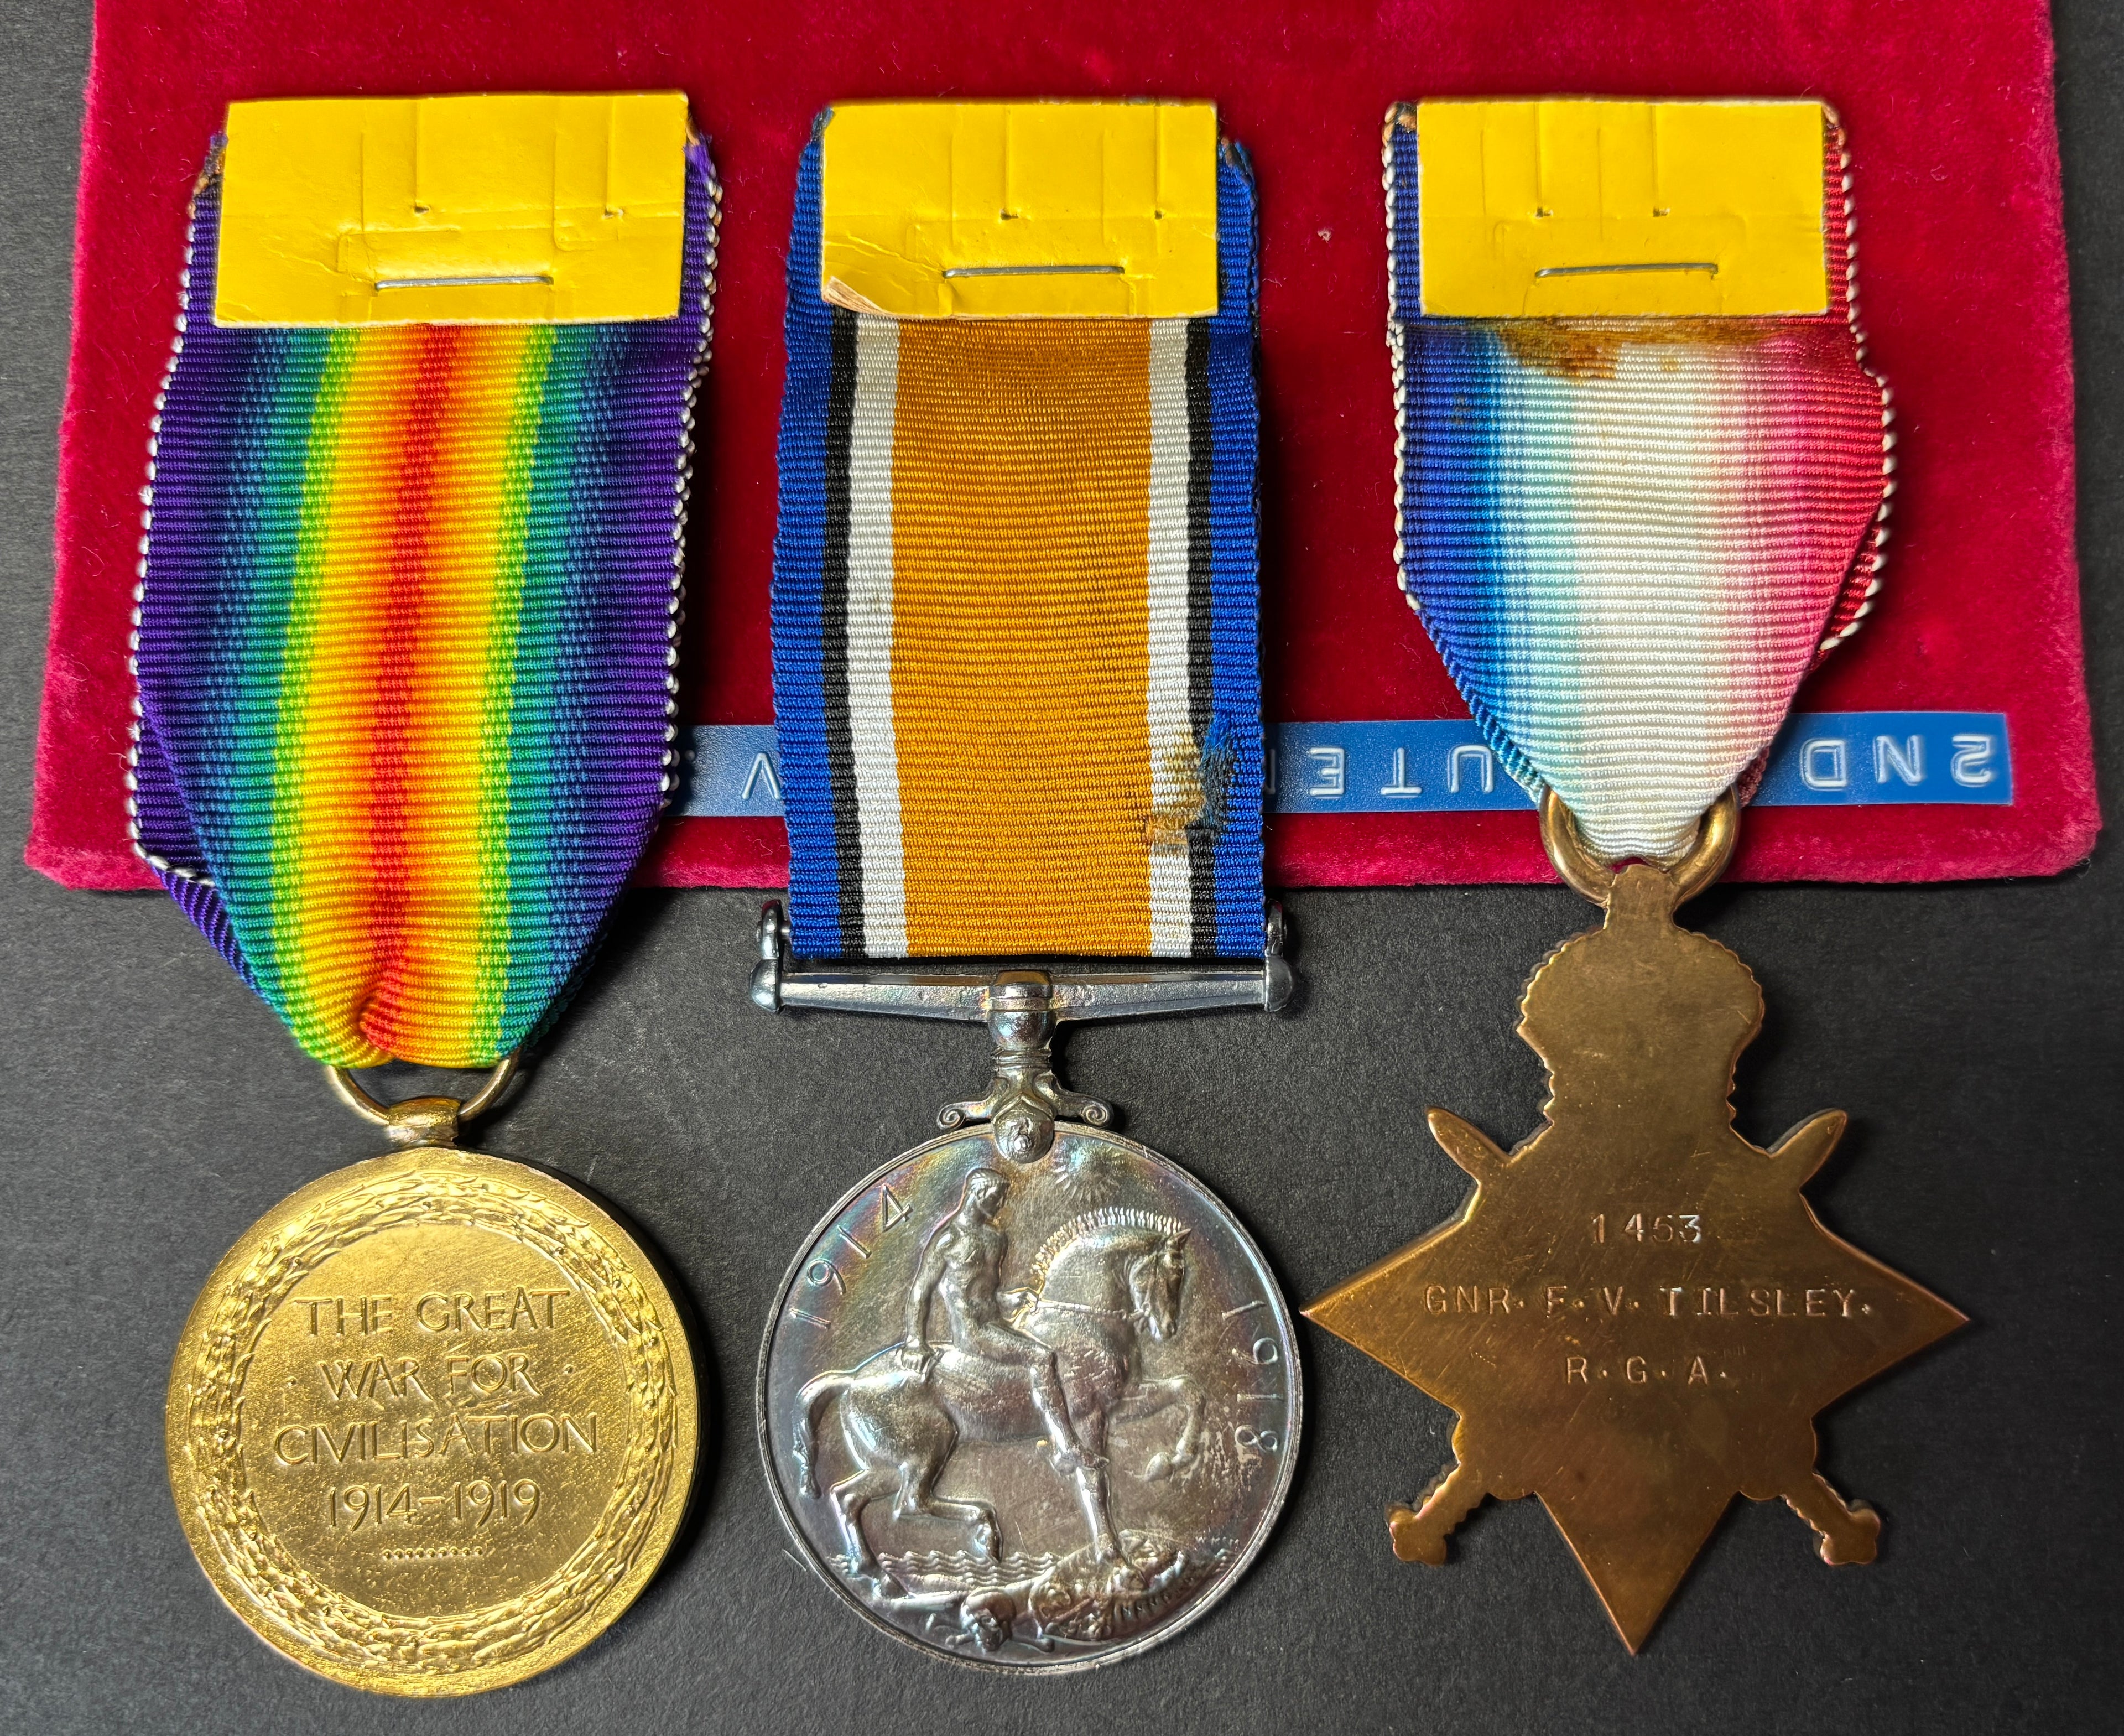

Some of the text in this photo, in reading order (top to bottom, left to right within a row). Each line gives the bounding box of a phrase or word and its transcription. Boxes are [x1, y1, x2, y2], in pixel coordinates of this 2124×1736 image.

[1800, 734, 1993, 791] 2ND
[789, 1183, 911, 1329] 1914
[290, 1286, 572, 1336] THE GREAT
[317, 1353, 543, 1402] WAR FOR
[1221, 1299, 1284, 1453] 1918
[275, 1412, 598, 1466] CIVILISATION
